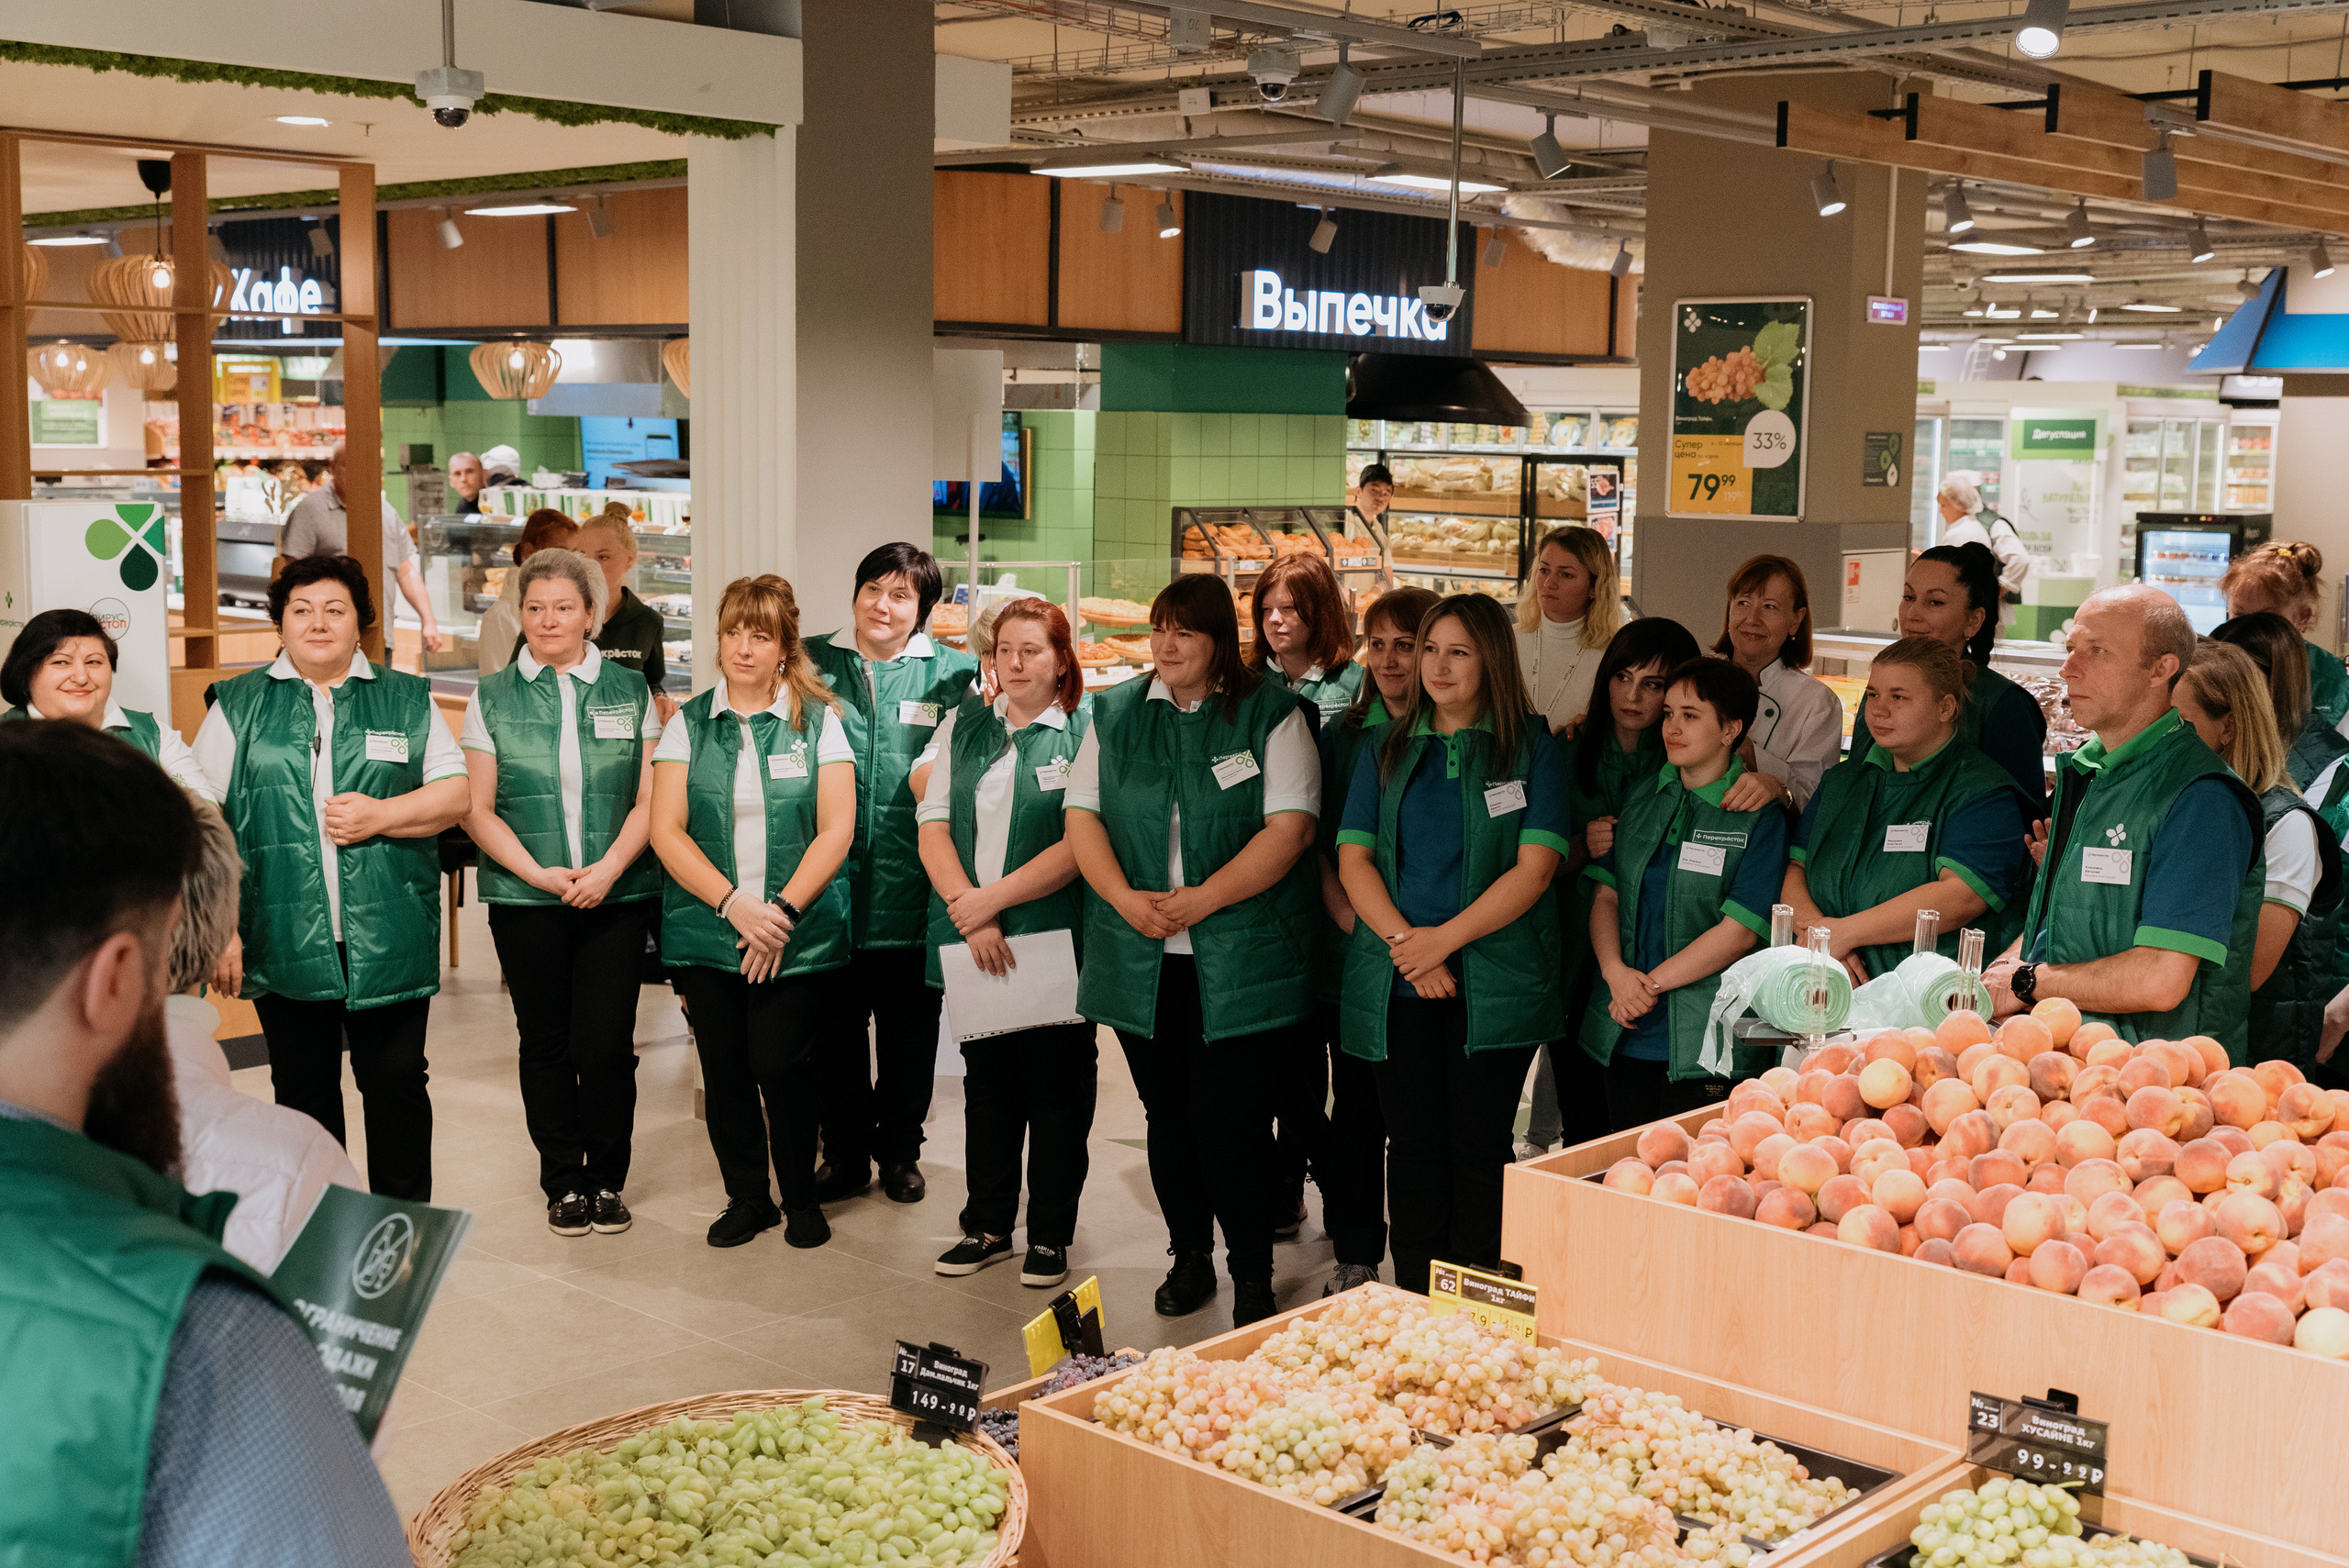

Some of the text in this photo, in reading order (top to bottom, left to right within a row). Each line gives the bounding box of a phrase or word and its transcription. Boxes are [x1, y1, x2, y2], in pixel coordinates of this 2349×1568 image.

[1675, 439, 1703, 450] Супер
[1753, 432, 1787, 450] 33%
[1675, 451, 1697, 460] цена
[601, 649, 642, 660] крёсток
[1702, 834, 1745, 843] Перекрёсток
[1440, 1278, 1457, 1293] 62
[1463, 1277, 1535, 1304] Виноград ТАЙФИ
[1490, 1294, 1506, 1304] 1кг
[900, 1359, 916, 1374] 17
[933, 1360, 968, 1378] Виноград
[966, 1380, 980, 1391] 1кг
[1976, 1411, 1998, 1429] 23
[2032, 1415, 2086, 1437] Виноград
[2021, 1423, 2096, 1450] ХУСАЙНЕ 1кг
